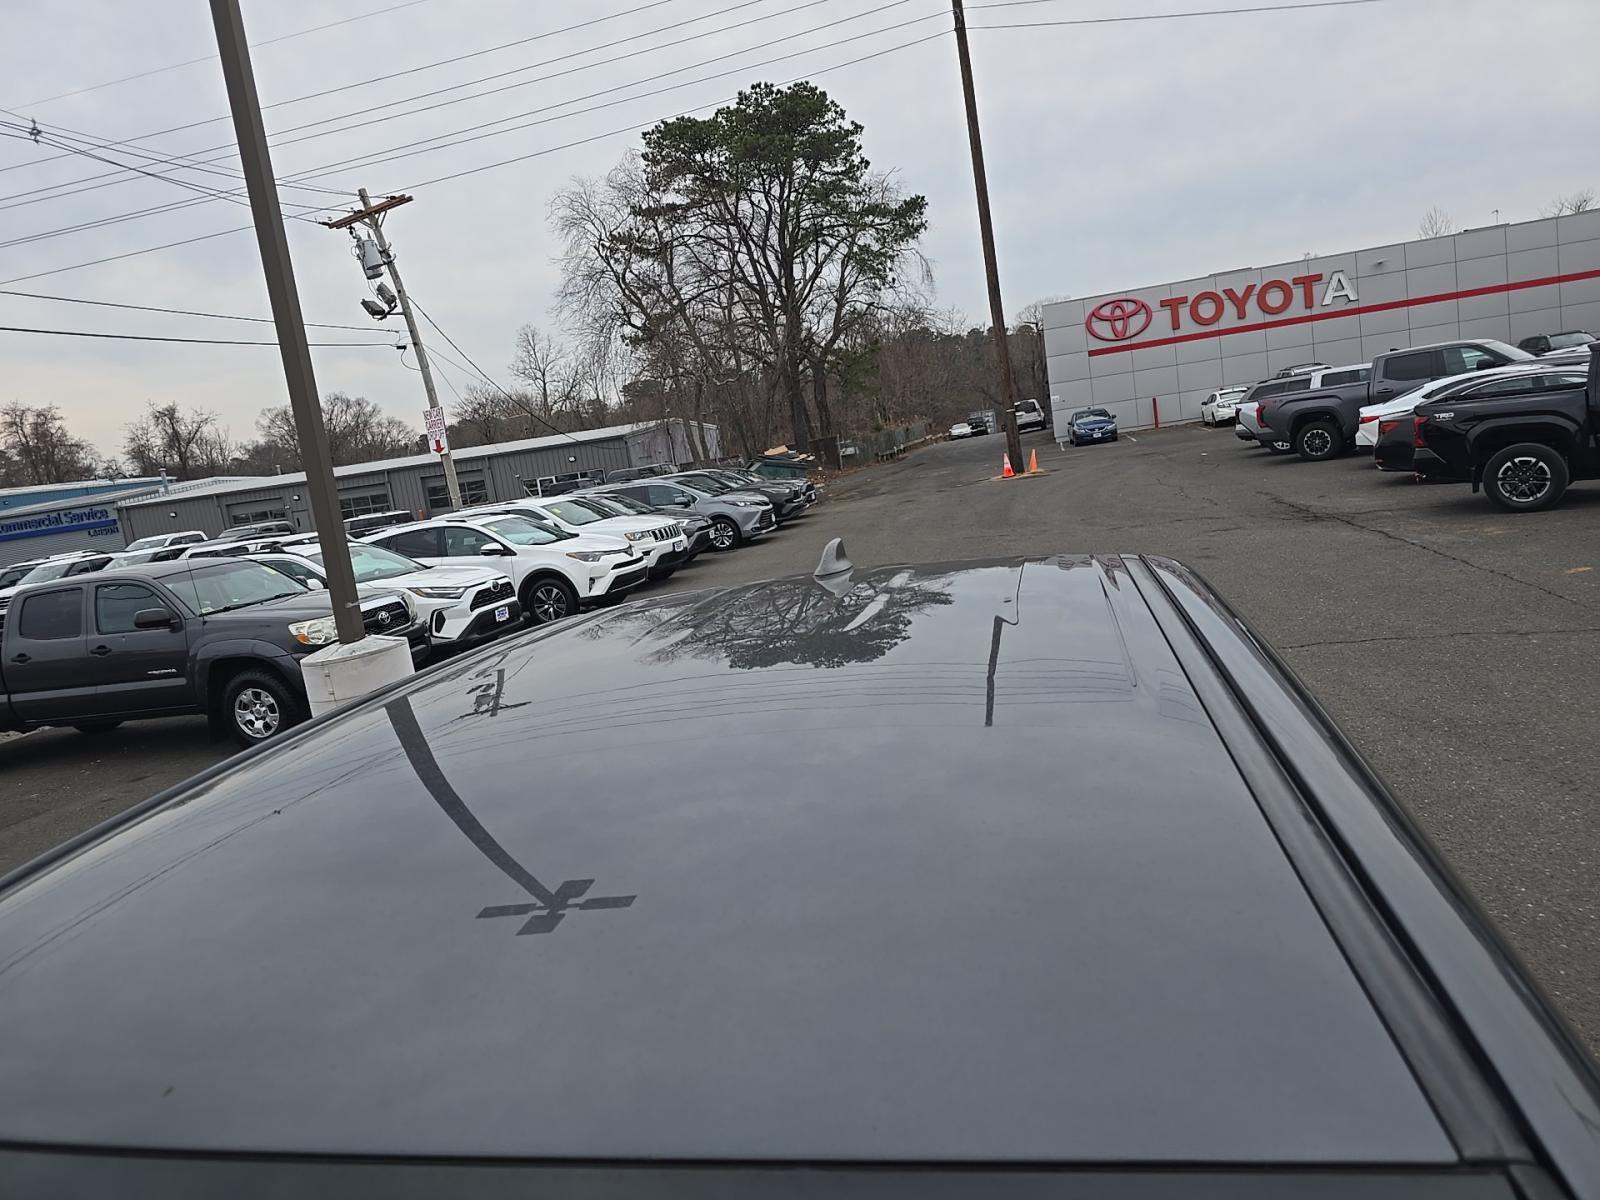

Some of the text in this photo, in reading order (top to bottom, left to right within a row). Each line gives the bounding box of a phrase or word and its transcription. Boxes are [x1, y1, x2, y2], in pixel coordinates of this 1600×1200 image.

[1160, 269, 1359, 330] TOYOTA
[0, 508, 109, 533] ommercial Service
